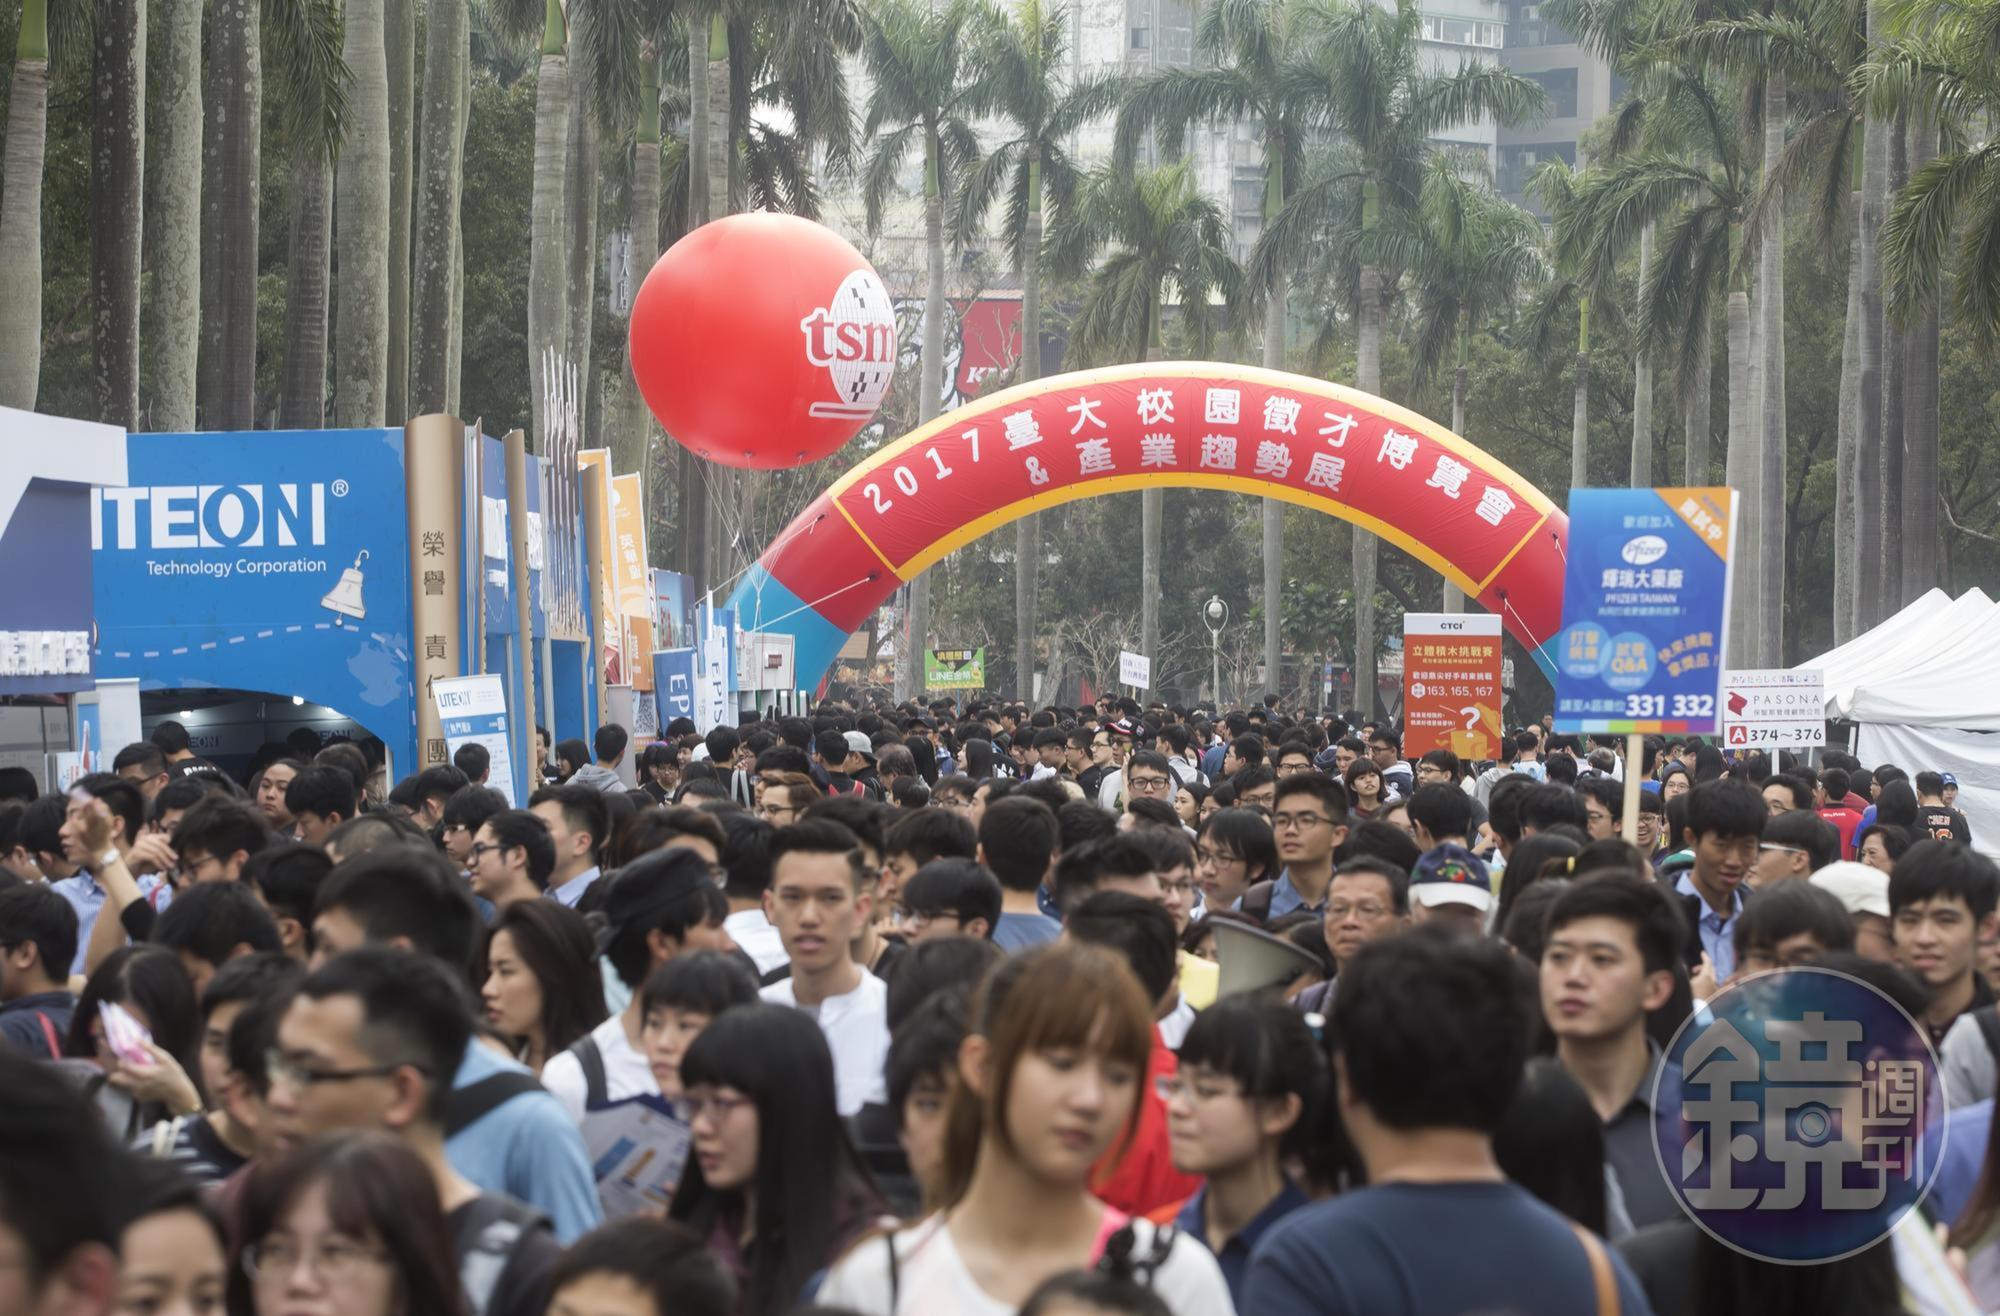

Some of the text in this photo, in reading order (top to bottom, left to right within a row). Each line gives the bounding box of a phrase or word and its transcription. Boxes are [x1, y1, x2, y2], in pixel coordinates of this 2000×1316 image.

[806, 313, 894, 362] tsm
[1075, 433, 1346, 492] 產業趨勢展
[91, 483, 325, 550] ITEON
[1627, 541, 1665, 564] Pfizer
[146, 558, 327, 578] Technology Corporation
[1605, 593, 1677, 604] PFIZER TAIWAN
[1440, 622, 1463, 630] CTCI
[1412, 645, 1493, 657] 立體積木挑戰賽
[1611, 657, 1648, 673] Q&A
[669, 673, 691, 722] EPI
[711, 662, 723, 723] EPIS
[1427, 686, 1448, 698] 163,
[1475, 686, 1493, 697] 167
[1753, 694, 1820, 705] PASONA
[1625, 694, 1665, 717] 331
[1672, 694, 1714, 717] 332
